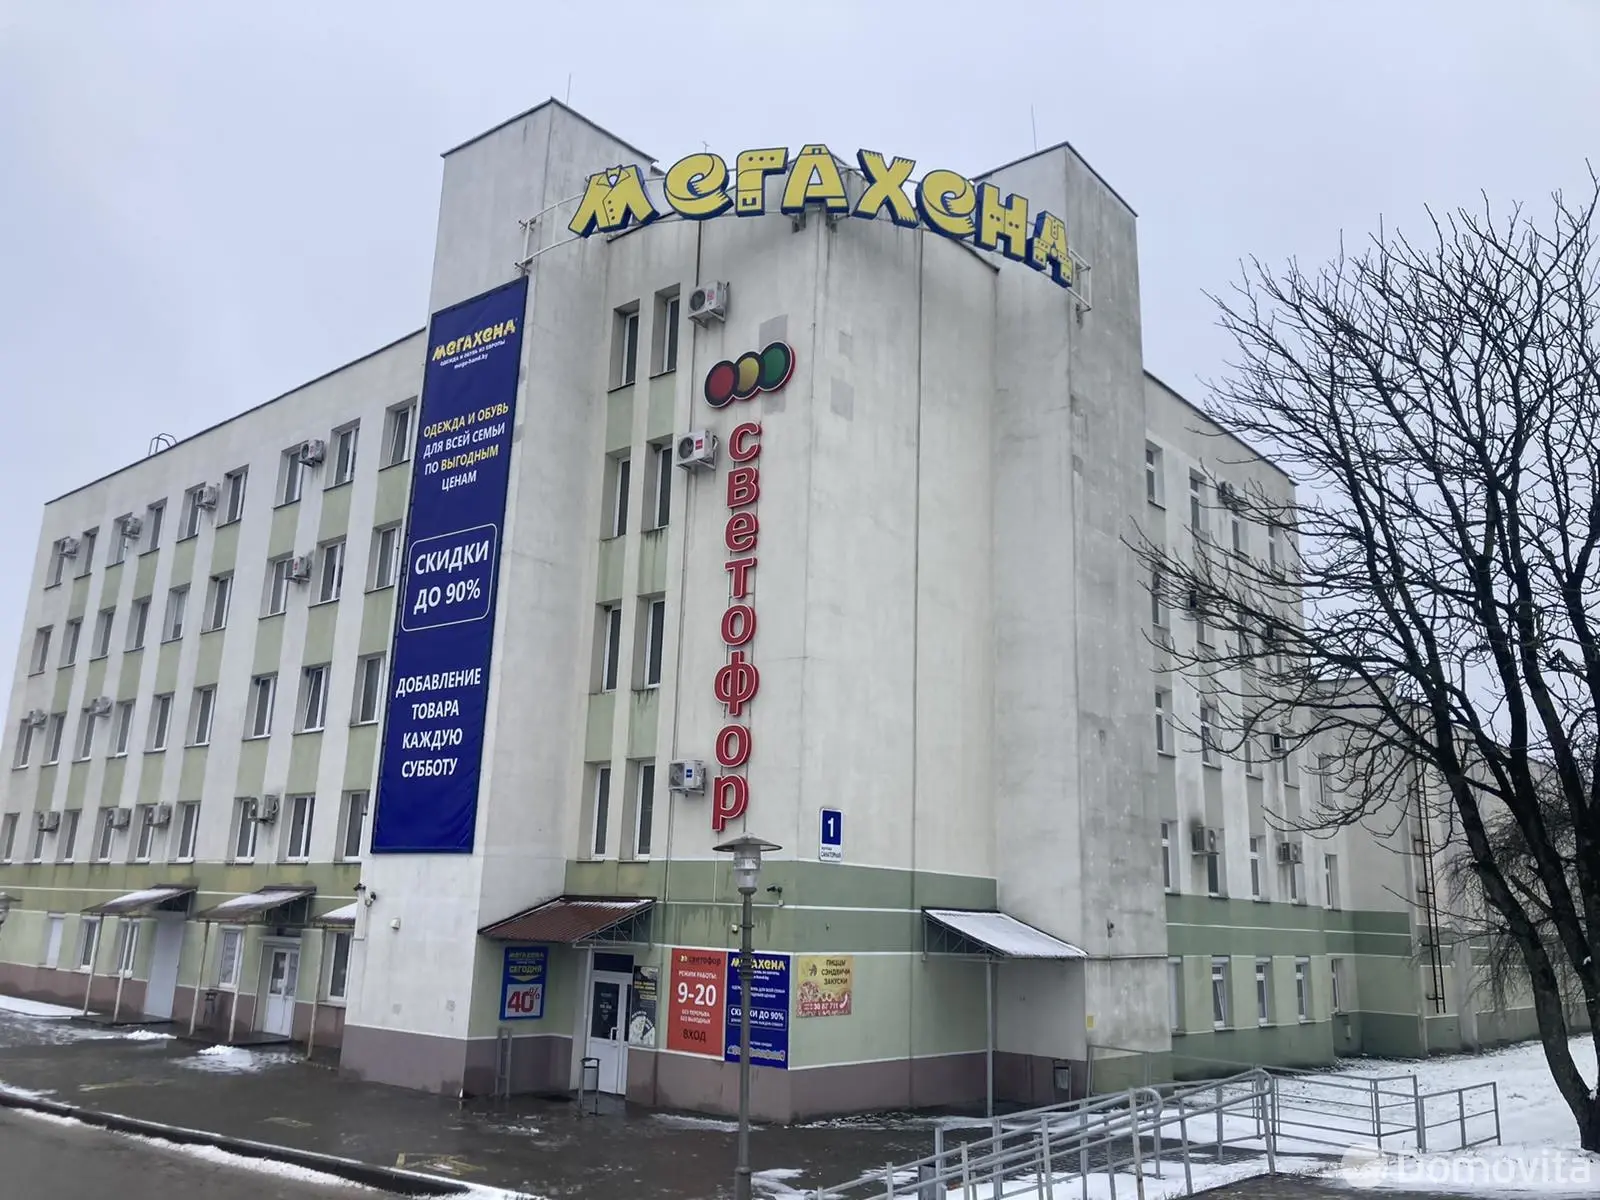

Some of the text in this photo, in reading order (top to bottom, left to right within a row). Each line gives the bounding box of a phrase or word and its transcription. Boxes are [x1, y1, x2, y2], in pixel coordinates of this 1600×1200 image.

[423, 402, 509, 438] ОДЕЖДА И ОБУВЬ
[423, 422, 505, 459] ДЛЯ ВСЕЙ СЕМЬИ
[424, 444, 499, 476] ПО ВЫГОДНЫМ
[441, 470, 477, 492] ЦЕНАМ
[415, 540, 490, 575] СКИДКИ
[413, 578, 481, 615] ДО 90%
[395, 667, 482, 698] ДОБАВЛЕНИЕ
[411, 699, 460, 721] ТОВАРА
[402, 727, 463, 752] КАЖДУЮ
[401, 757, 458, 779] СУББОТУ
[827, 817, 834, 838] 1
[507, 987, 541, 1013] 40%
[677, 982, 717, 1007] 9-20
[730, 1007, 784, 1021] СКИКИ ДО 90%
[682, 1029, 706, 1043] ВХОД
